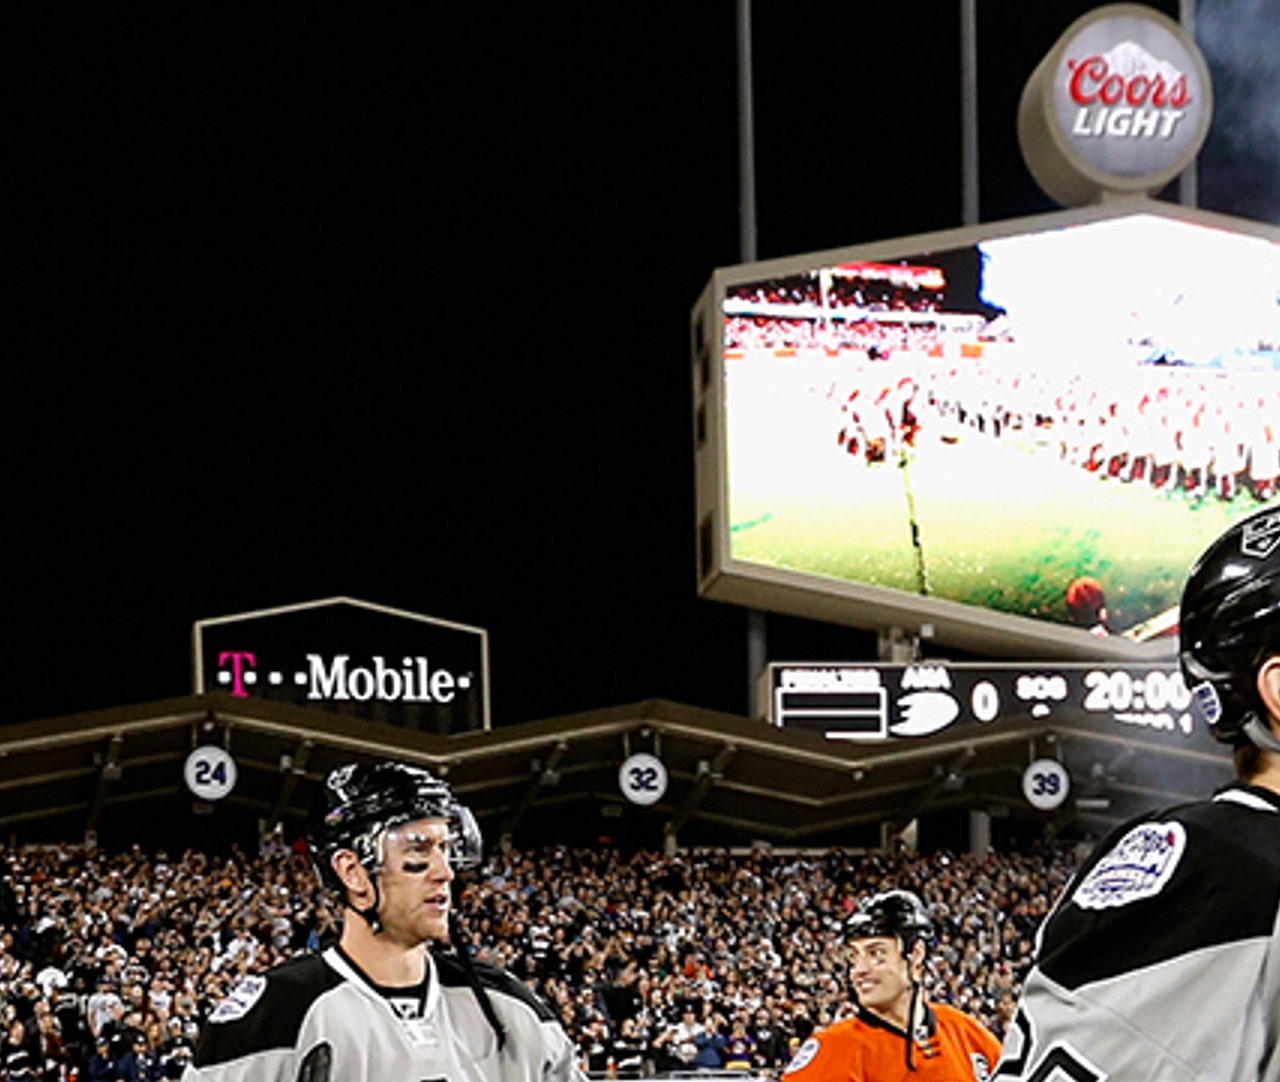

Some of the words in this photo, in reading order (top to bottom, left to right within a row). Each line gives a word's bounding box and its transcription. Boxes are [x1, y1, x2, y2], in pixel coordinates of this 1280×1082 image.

[1067, 55, 1191, 108] Coors
[1072, 107, 1186, 139] LIGHT
[195, 761, 227, 785] 24
[629, 767, 659, 792] 32
[1032, 772, 1061, 796] 39
